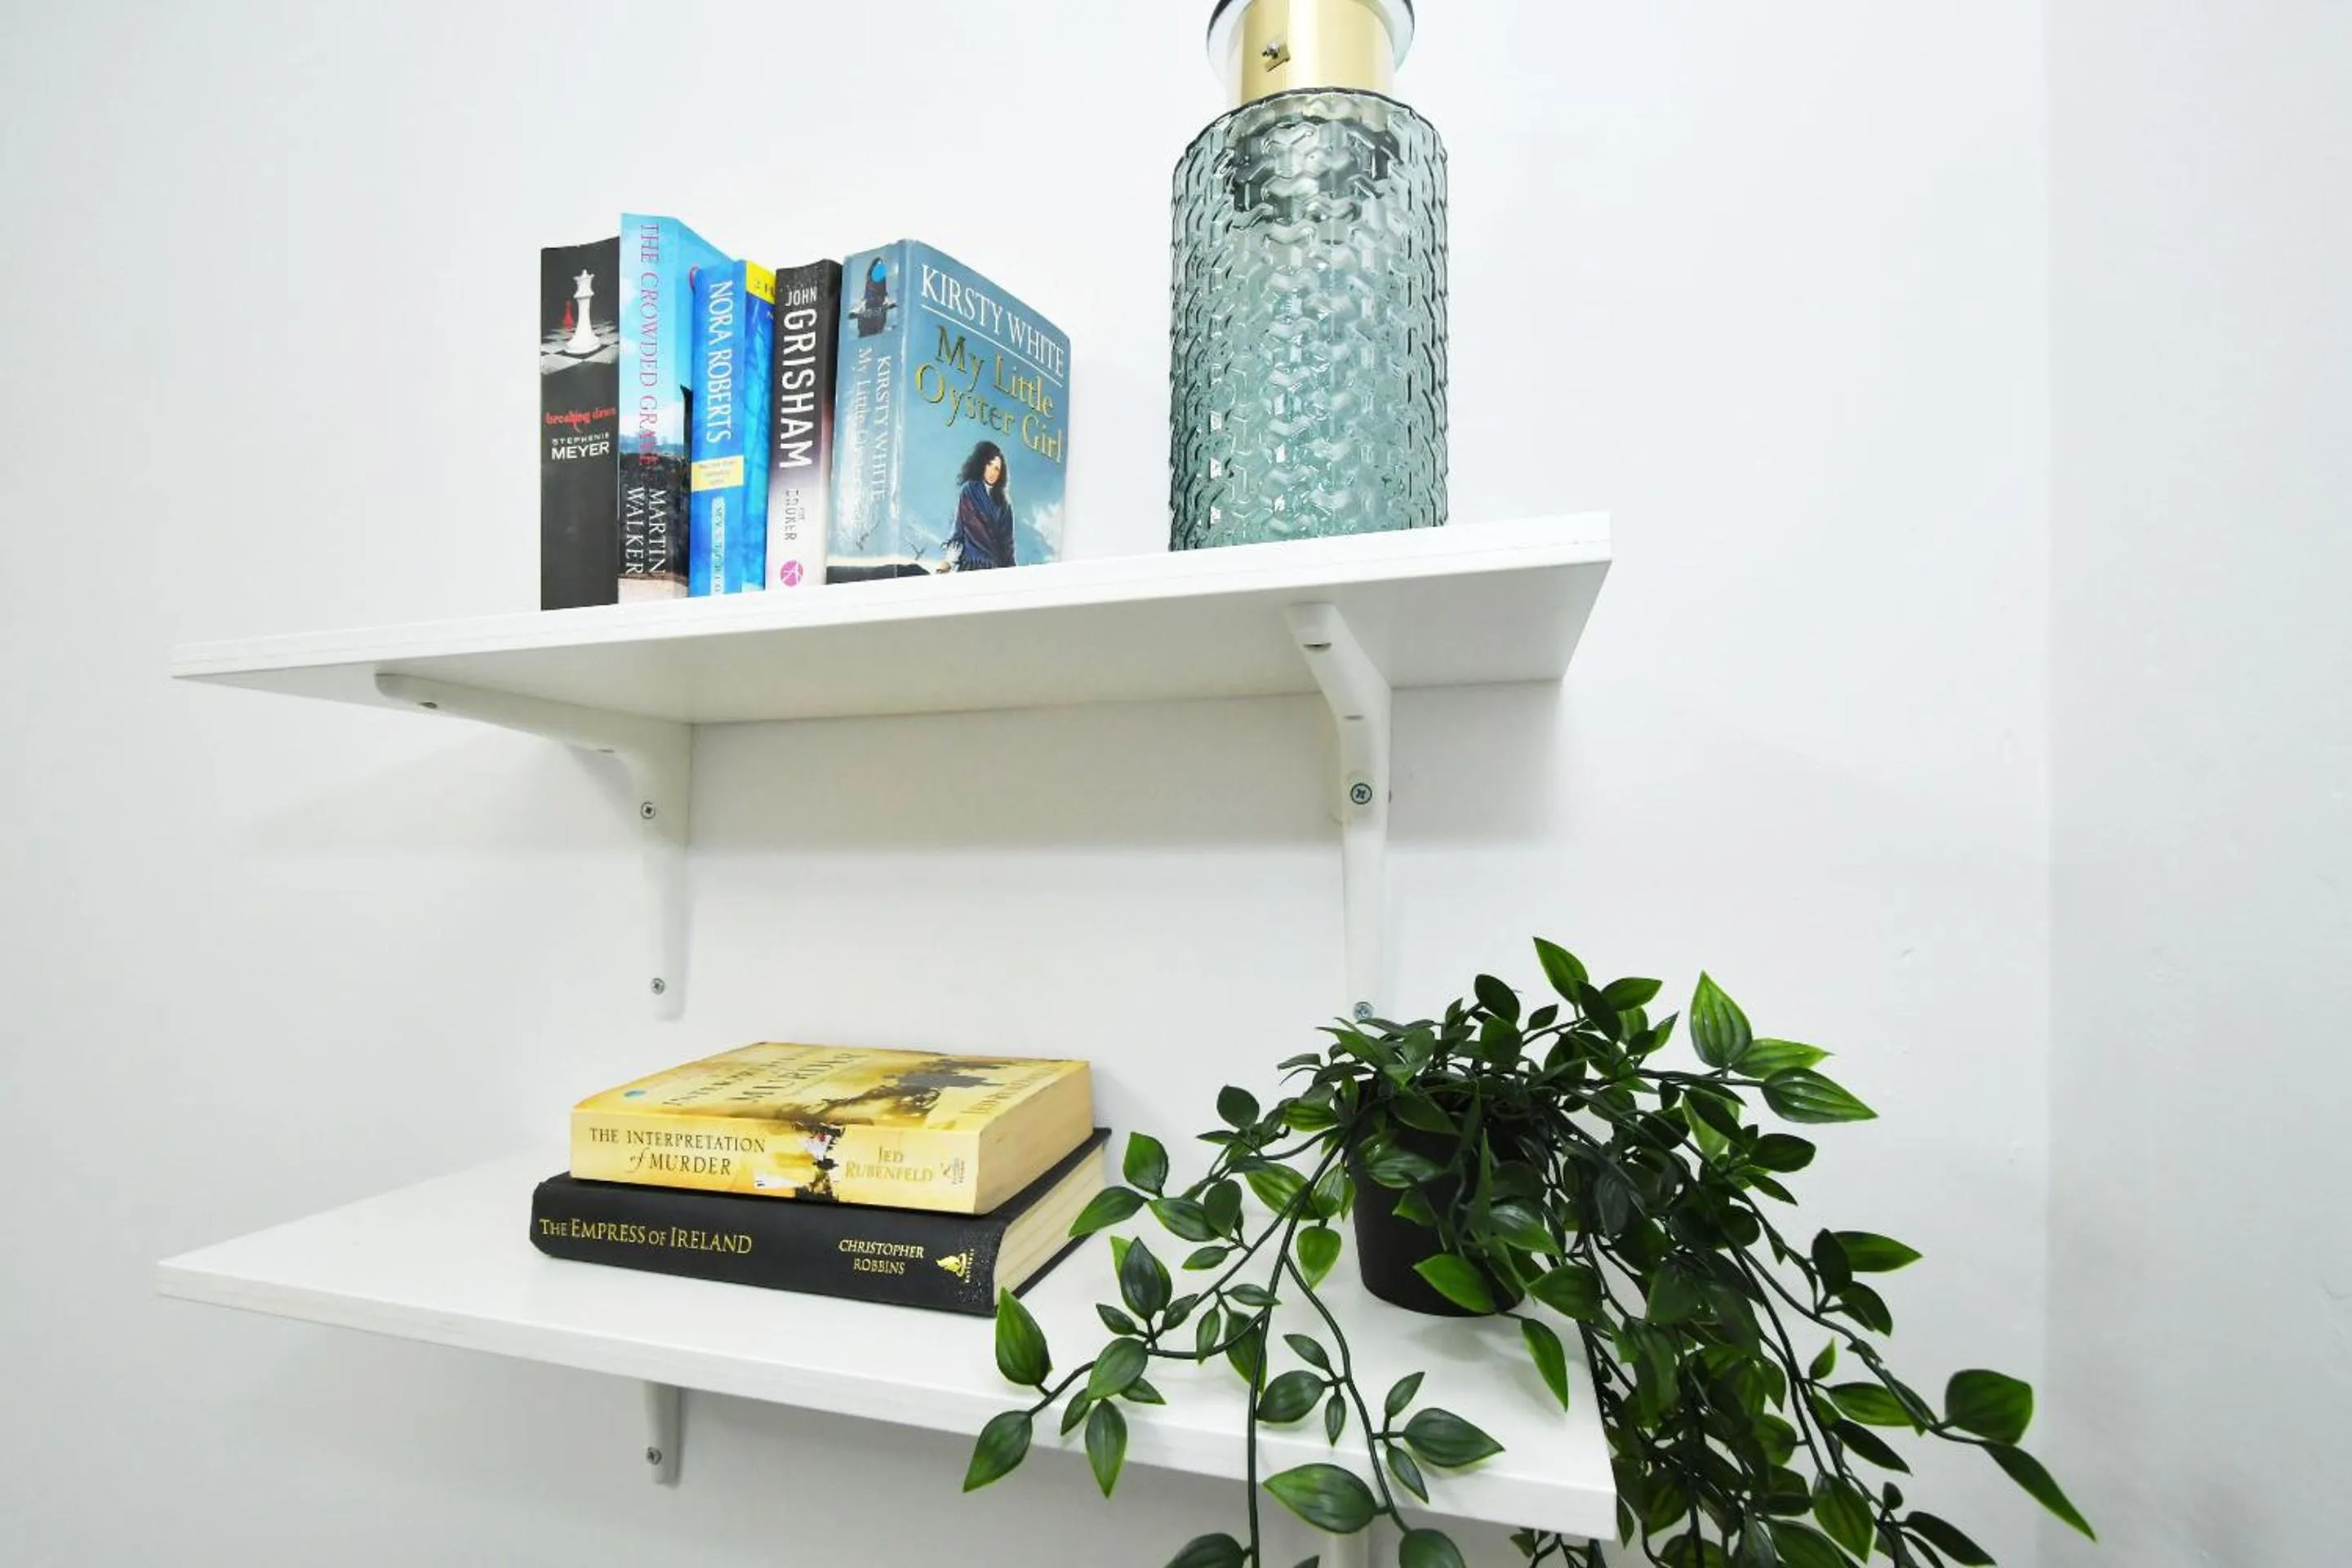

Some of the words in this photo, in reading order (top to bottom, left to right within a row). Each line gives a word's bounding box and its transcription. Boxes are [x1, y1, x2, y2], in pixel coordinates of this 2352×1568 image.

[640, 224, 660, 263] THE
[639, 272, 660, 387] CROWDED
[709, 280, 734, 346] NORA
[785, 286, 817, 307] JOHN
[921, 264, 1003, 335] KIRSTY
[1007, 311, 1065, 378] WHITE
[706, 349, 733, 444] ROBERTS
[779, 308, 818, 469] GRISHAM
[874, 355, 891, 426] KIRSTY
[934, 326, 985, 393] My
[994, 353, 1055, 420] Little
[552, 432, 610, 446] STEPHENIE
[639, 395, 660, 466] GRAVE
[914, 363, 1015, 435] Oyster
[1022, 413, 1062, 464] Girl
[552, 441, 610, 460] MEYER
[870, 430, 890, 501] WHITE
[625, 486, 645, 575] WALKER
[648, 488, 667, 575] MARTIN
[589, 1127, 619, 1144] THE
[627, 1130, 766, 1153] INTERPRETATION
[650, 1153, 731, 1175] MURDER
[845, 1162, 934, 1182] RUBENFELD
[878, 1146, 904, 1164] JED
[539, 1219, 567, 1237] THE
[570, 1218, 646, 1245] EMPRESS
[670, 1227, 754, 1254] IRELAND
[838, 1239, 925, 1259] CHRISTOPHER
[852, 1258, 906, 1275] ROBBINS
